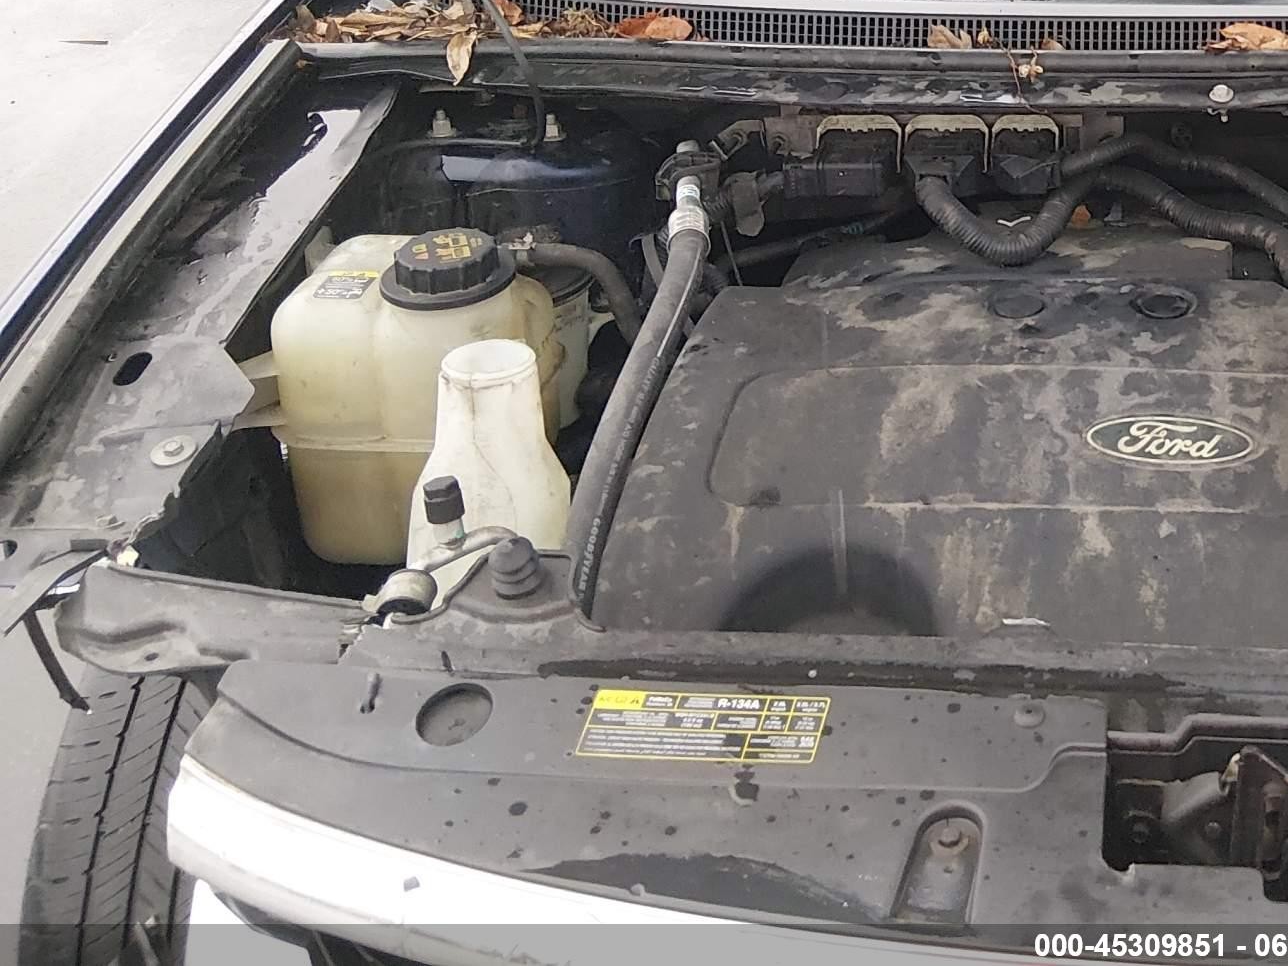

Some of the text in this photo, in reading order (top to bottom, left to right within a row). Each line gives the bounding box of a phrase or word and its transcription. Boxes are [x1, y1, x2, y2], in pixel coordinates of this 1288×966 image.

[1117, 421, 1223, 458] Ford
[578, 518, 600, 591] GOODYEAR
[717, 698, 760, 709] R-134A
